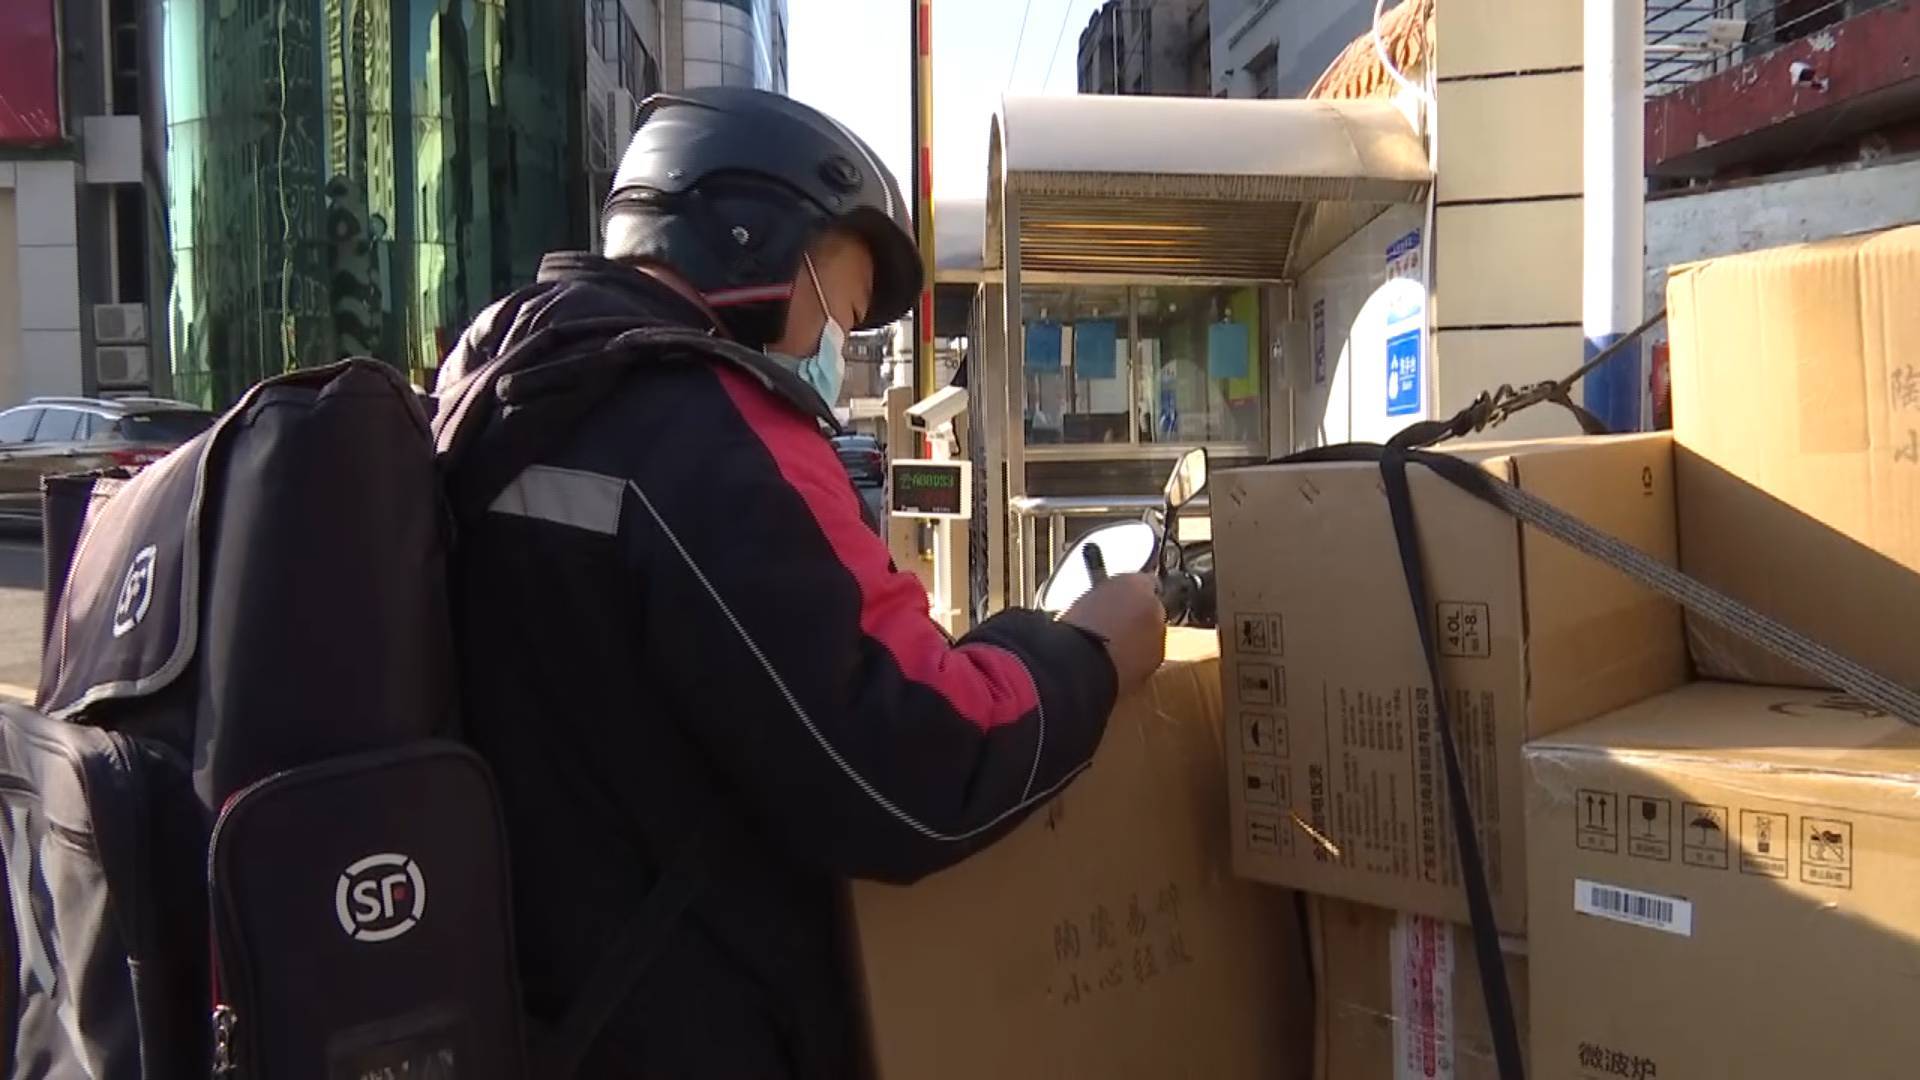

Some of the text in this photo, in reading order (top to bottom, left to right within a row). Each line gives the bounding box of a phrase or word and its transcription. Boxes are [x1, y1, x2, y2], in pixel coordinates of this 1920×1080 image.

[353, 872, 407, 922] SF
[1578, 1041, 1657, 1080] 微波炉
